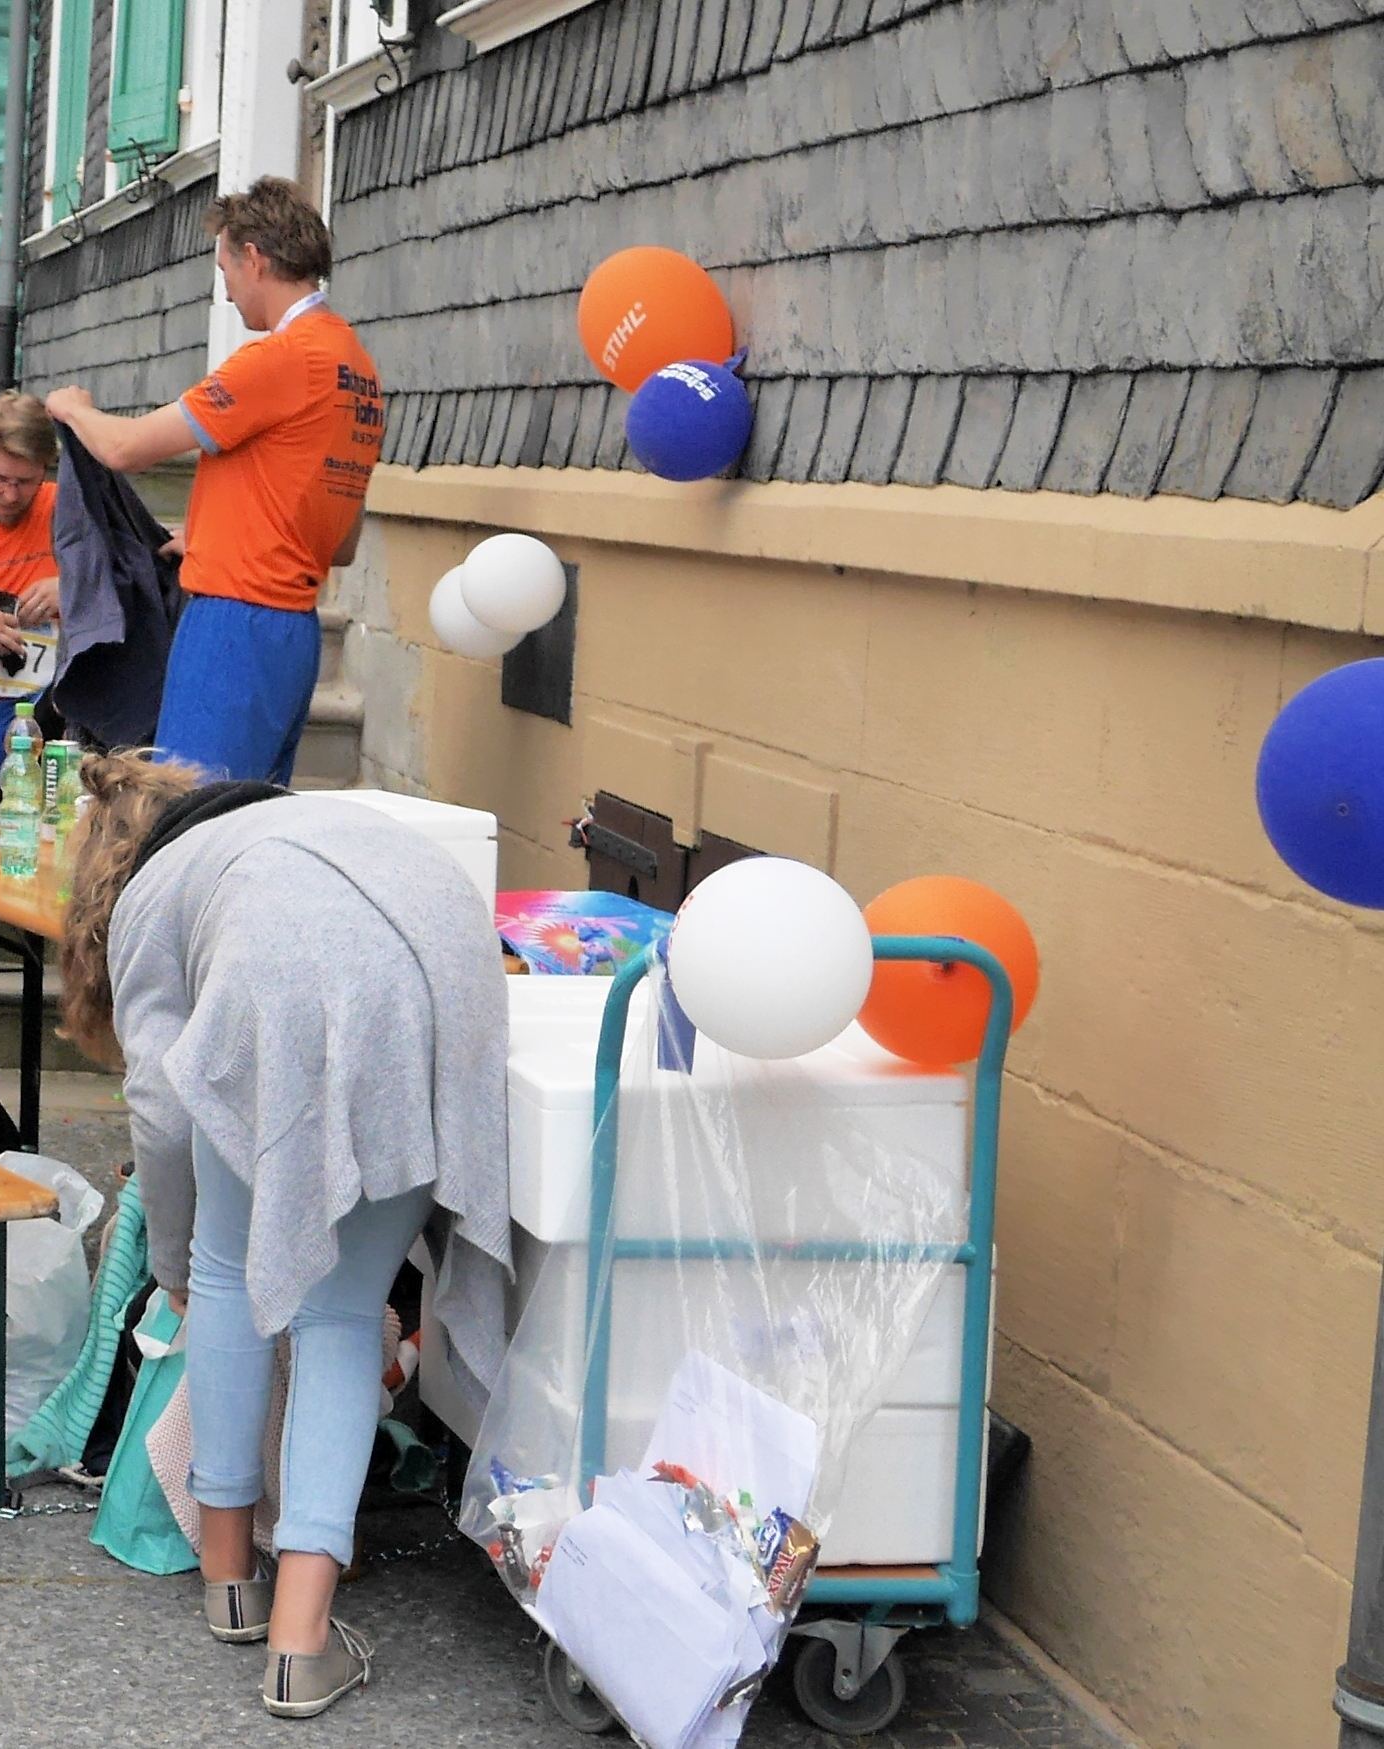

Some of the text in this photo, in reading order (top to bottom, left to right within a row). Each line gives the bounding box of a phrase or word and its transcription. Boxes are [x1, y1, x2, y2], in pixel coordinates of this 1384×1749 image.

[602, 308, 647, 373] STIHL
[45, 758, 58, 809] VELTINS
[766, 1551, 799, 1597] TWIX
